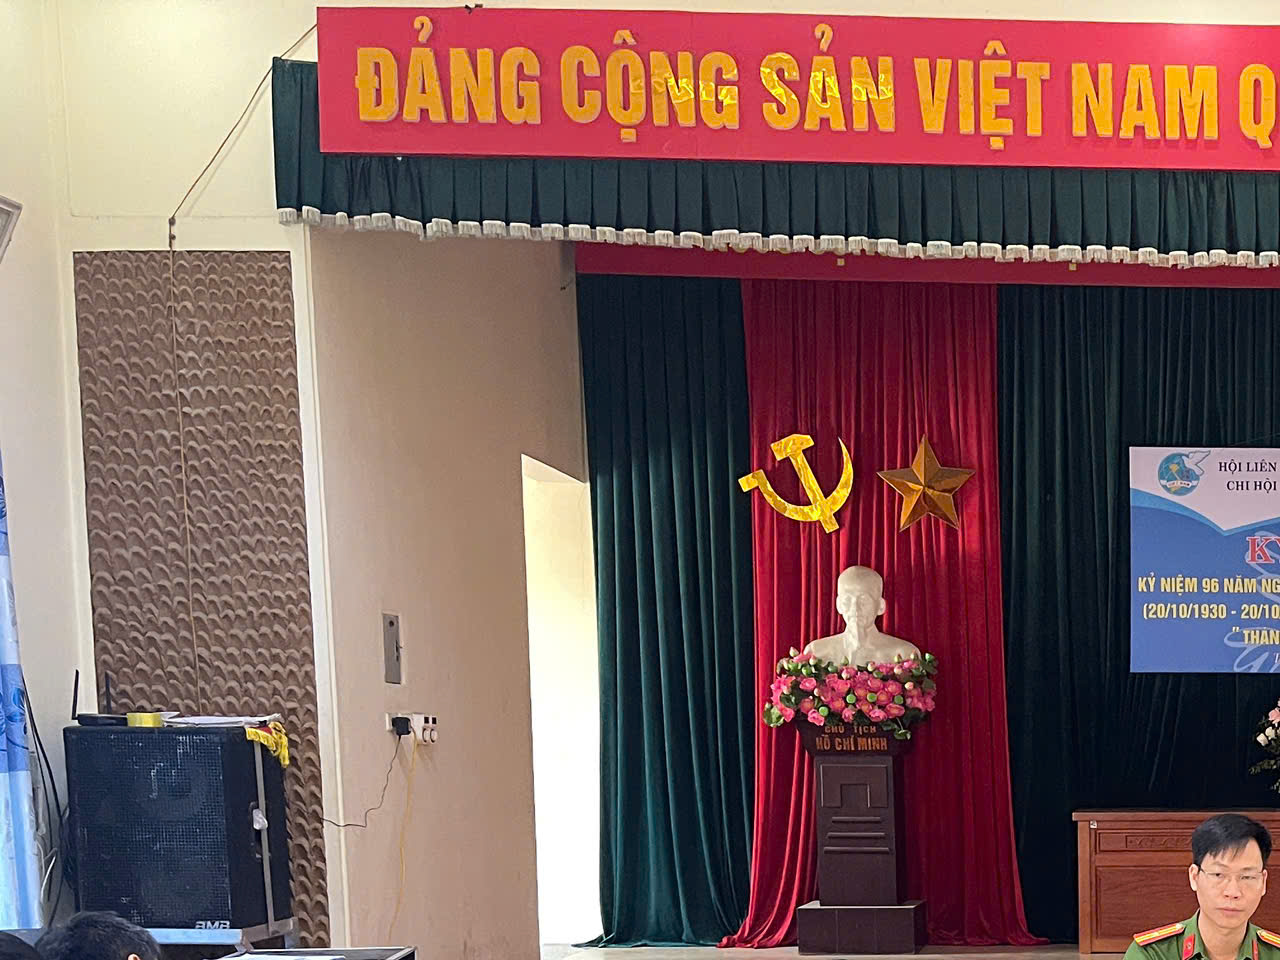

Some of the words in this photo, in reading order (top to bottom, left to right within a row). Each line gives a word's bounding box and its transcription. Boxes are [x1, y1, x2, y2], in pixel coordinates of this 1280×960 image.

[355, 17, 541, 125] ĐẢNG
[560, 29, 740, 142] CỘNG
[760, 23, 896, 133] SẢN
[913, 40, 1051, 149] VIỆT
[1072, 61, 1219, 141] NAM
[1218, 459, 1242, 474] HỘI
[1246, 459, 1277, 472] LIÊN
[1226, 480, 1250, 491] CHI
[1253, 478, 1277, 494] HỘI
[1138, 572, 1156, 592] KỶ
[1160, 574, 1198, 596] NIỆM
[1202, 577, 1219, 593] 96
[1223, 575, 1257, 593] NĂM
[1143, 603, 1227, 620] (20/10/1930
[816, 734, 830, 750] HỒ
[835, 735, 855, 750] CHÍ
[857, 737, 888, 751] MINH
